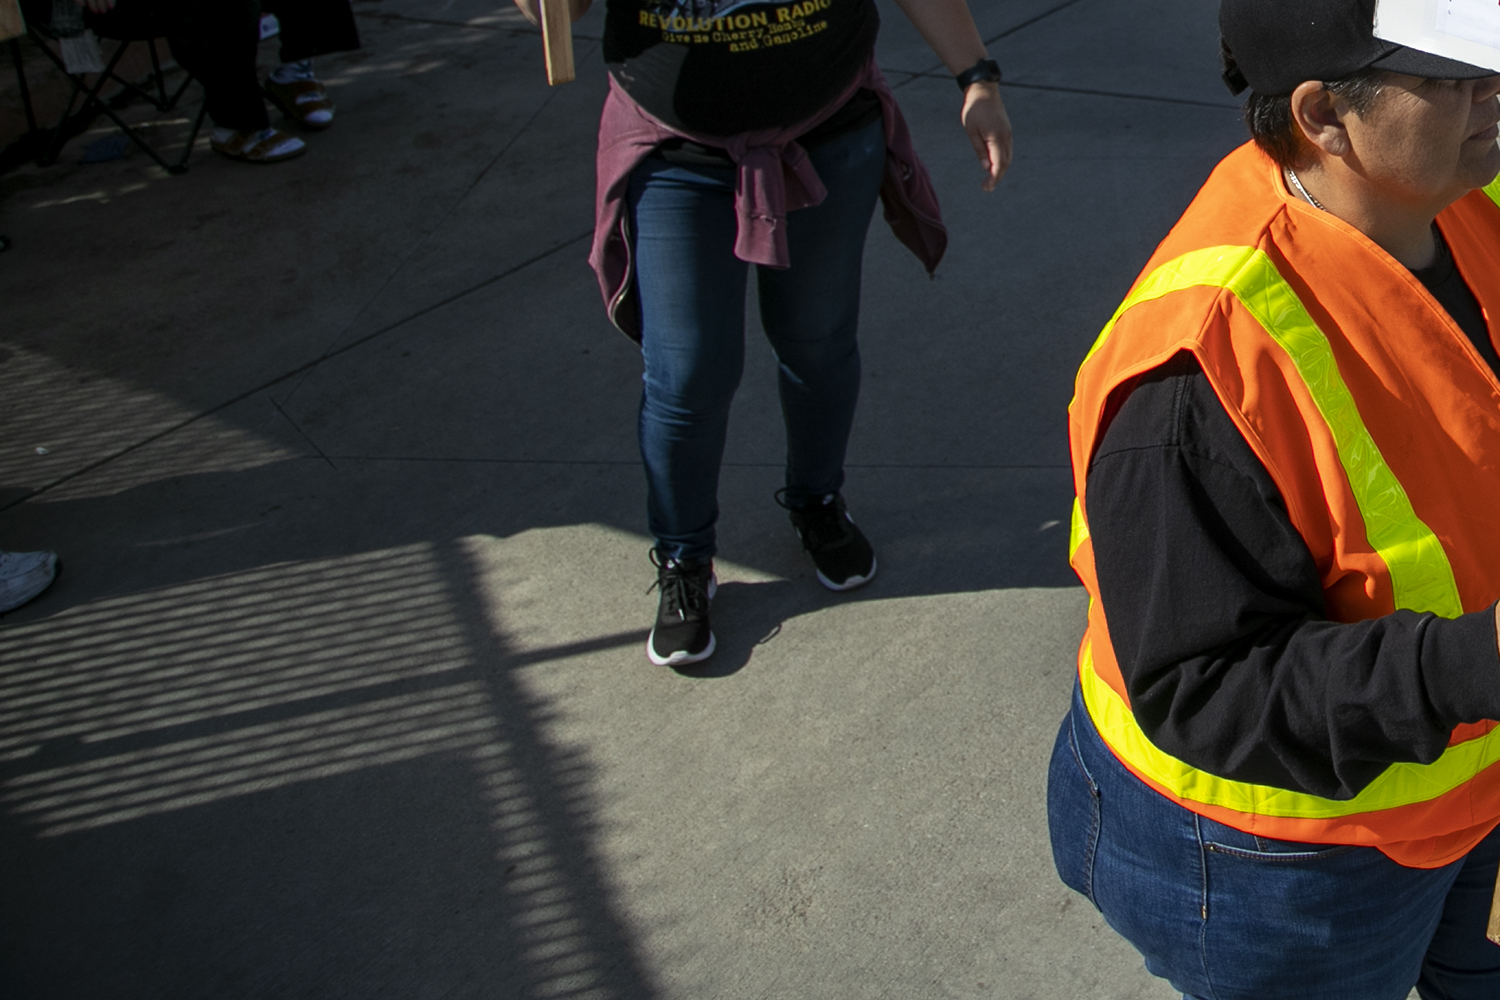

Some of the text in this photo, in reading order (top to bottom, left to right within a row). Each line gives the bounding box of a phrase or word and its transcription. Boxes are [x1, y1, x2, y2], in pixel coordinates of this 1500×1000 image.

[639, 9, 768, 32] REVOLUTION
[730, 20, 828, 52] and Gasoline
